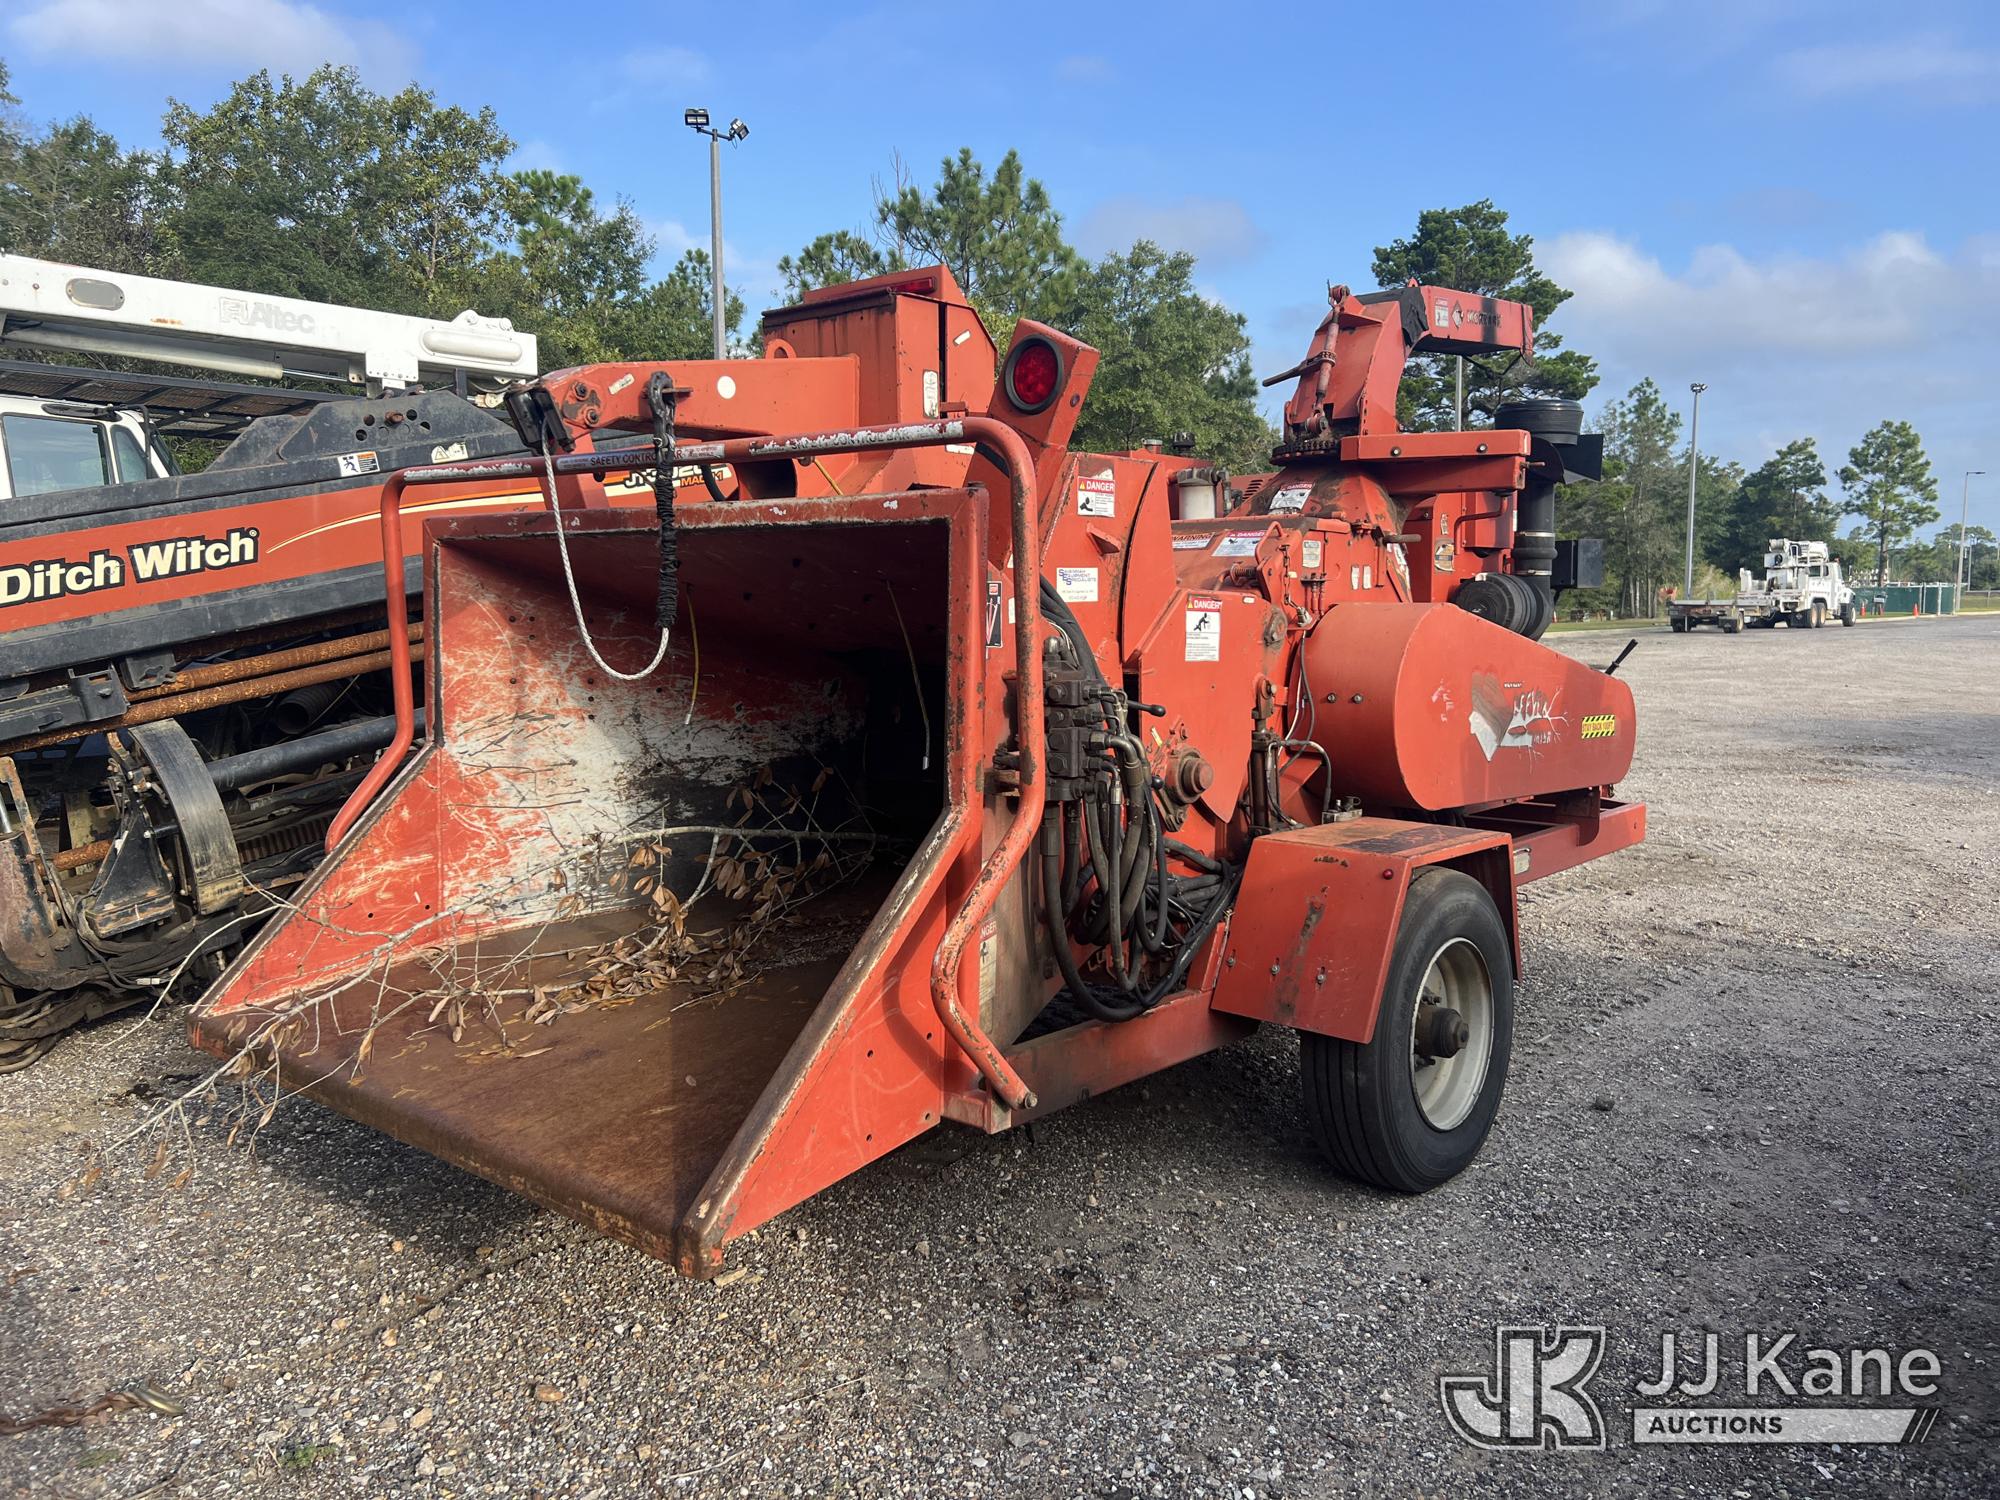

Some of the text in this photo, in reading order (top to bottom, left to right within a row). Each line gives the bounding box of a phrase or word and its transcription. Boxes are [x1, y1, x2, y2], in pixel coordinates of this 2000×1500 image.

[249, 302, 316, 334] Altec
[590, 453, 622, 467] SAFETY
[622, 449, 659, 465] CONTRO
[1086, 481, 1114, 491] DANGER
[0, 532, 255, 603] Ditch Witch
[1193, 600, 1221, 610] DANGER
